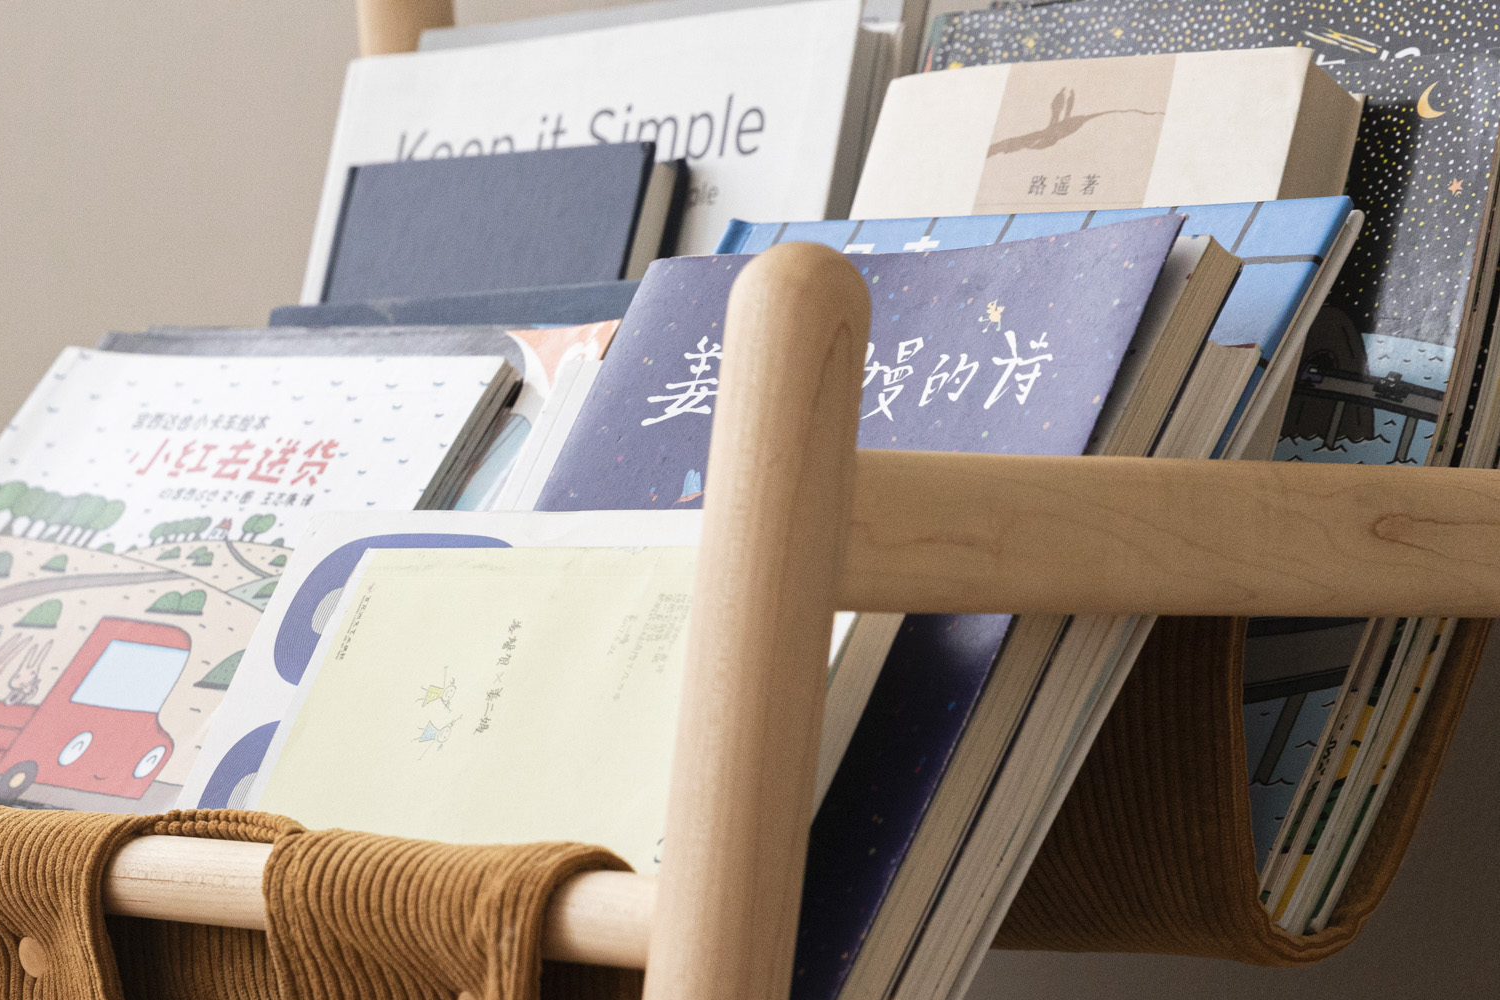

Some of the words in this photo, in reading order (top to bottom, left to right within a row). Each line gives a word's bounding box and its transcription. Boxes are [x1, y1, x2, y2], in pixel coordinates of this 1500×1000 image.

[589, 93, 765, 162] Simple
[1079, 173, 1101, 196] 著
[641, 330, 1053, 426] 姜嫚的诗
[128, 437, 339, 486] 小红去送货
